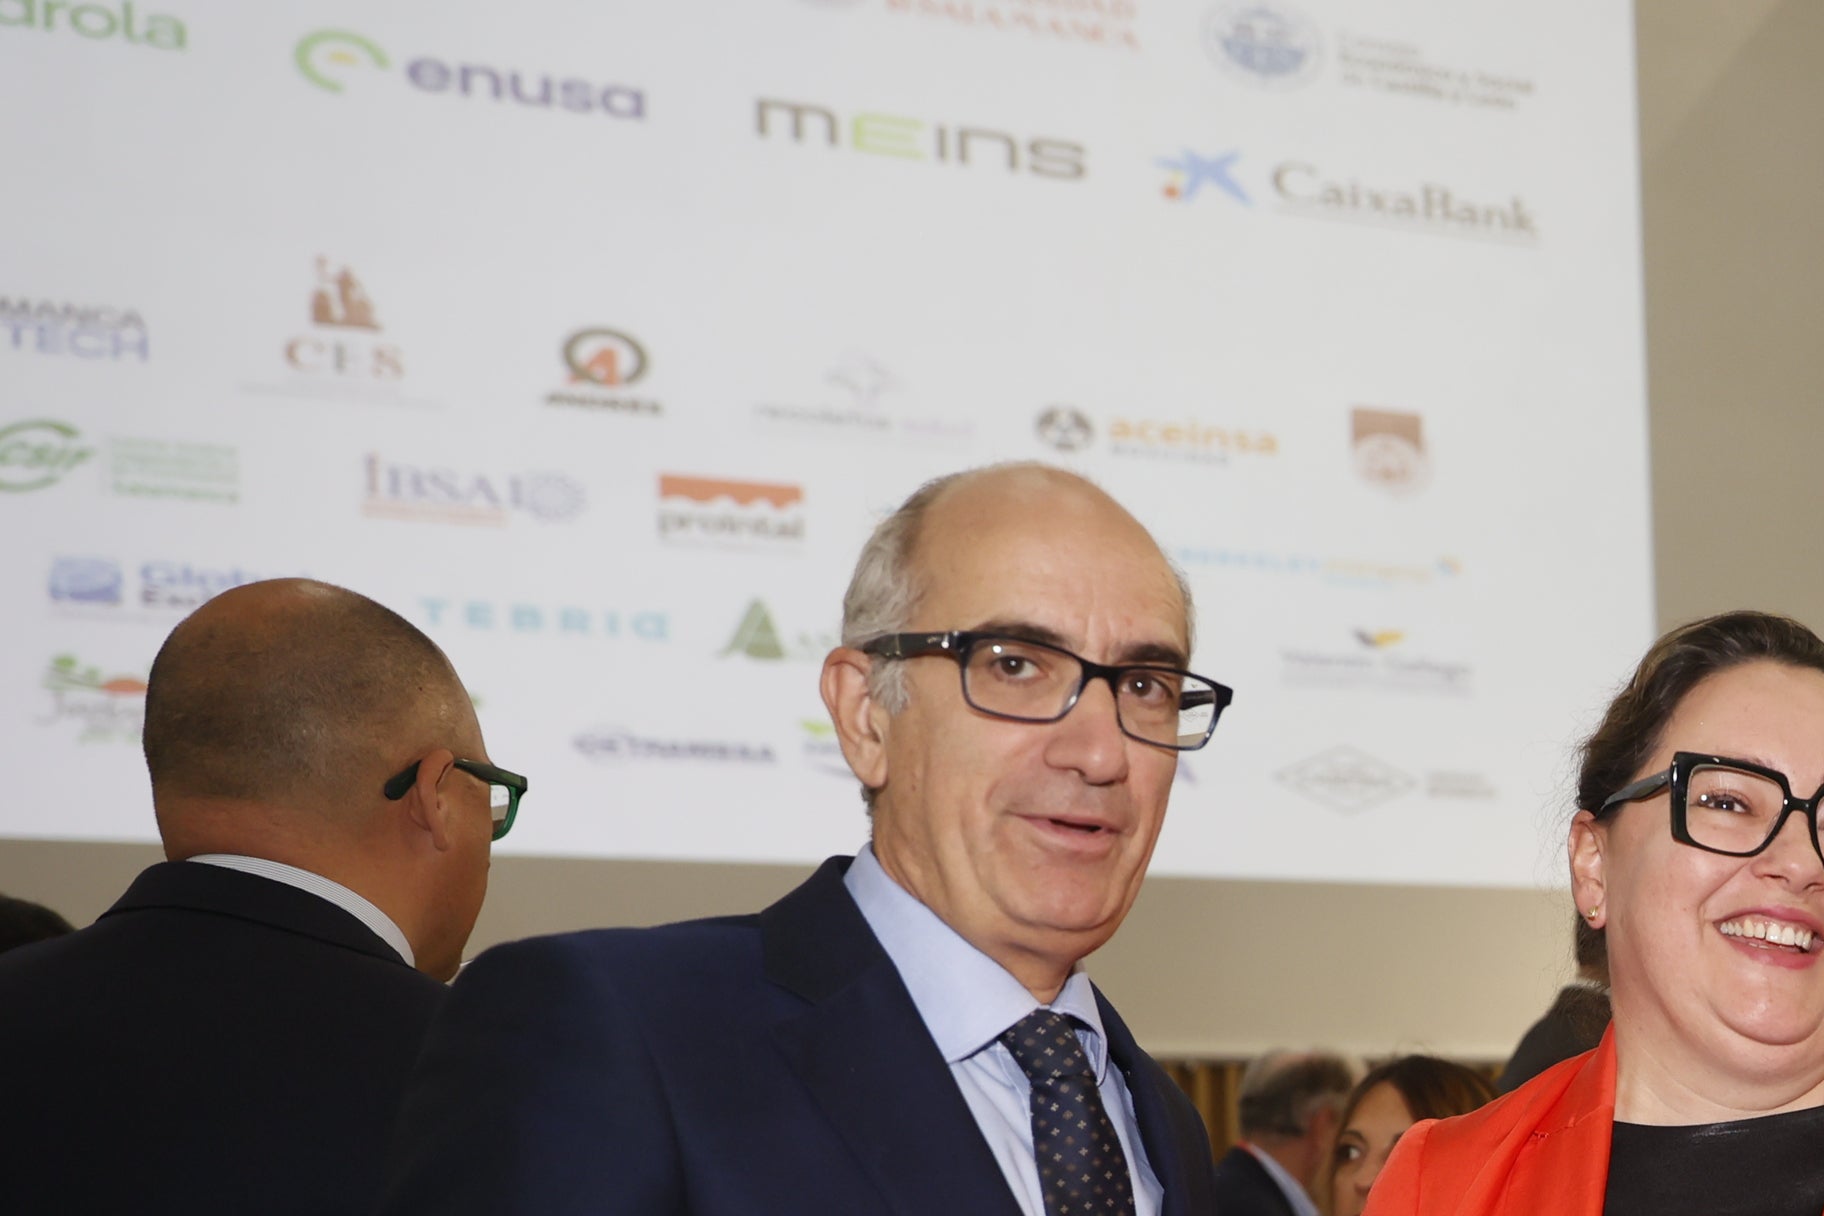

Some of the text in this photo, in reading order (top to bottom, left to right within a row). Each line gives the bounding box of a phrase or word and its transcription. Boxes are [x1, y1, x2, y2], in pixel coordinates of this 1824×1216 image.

[405, 55, 648, 122] enusa
[1271, 158, 1540, 239] CaixaBank
[1108, 415, 1280, 457] aceinsa
